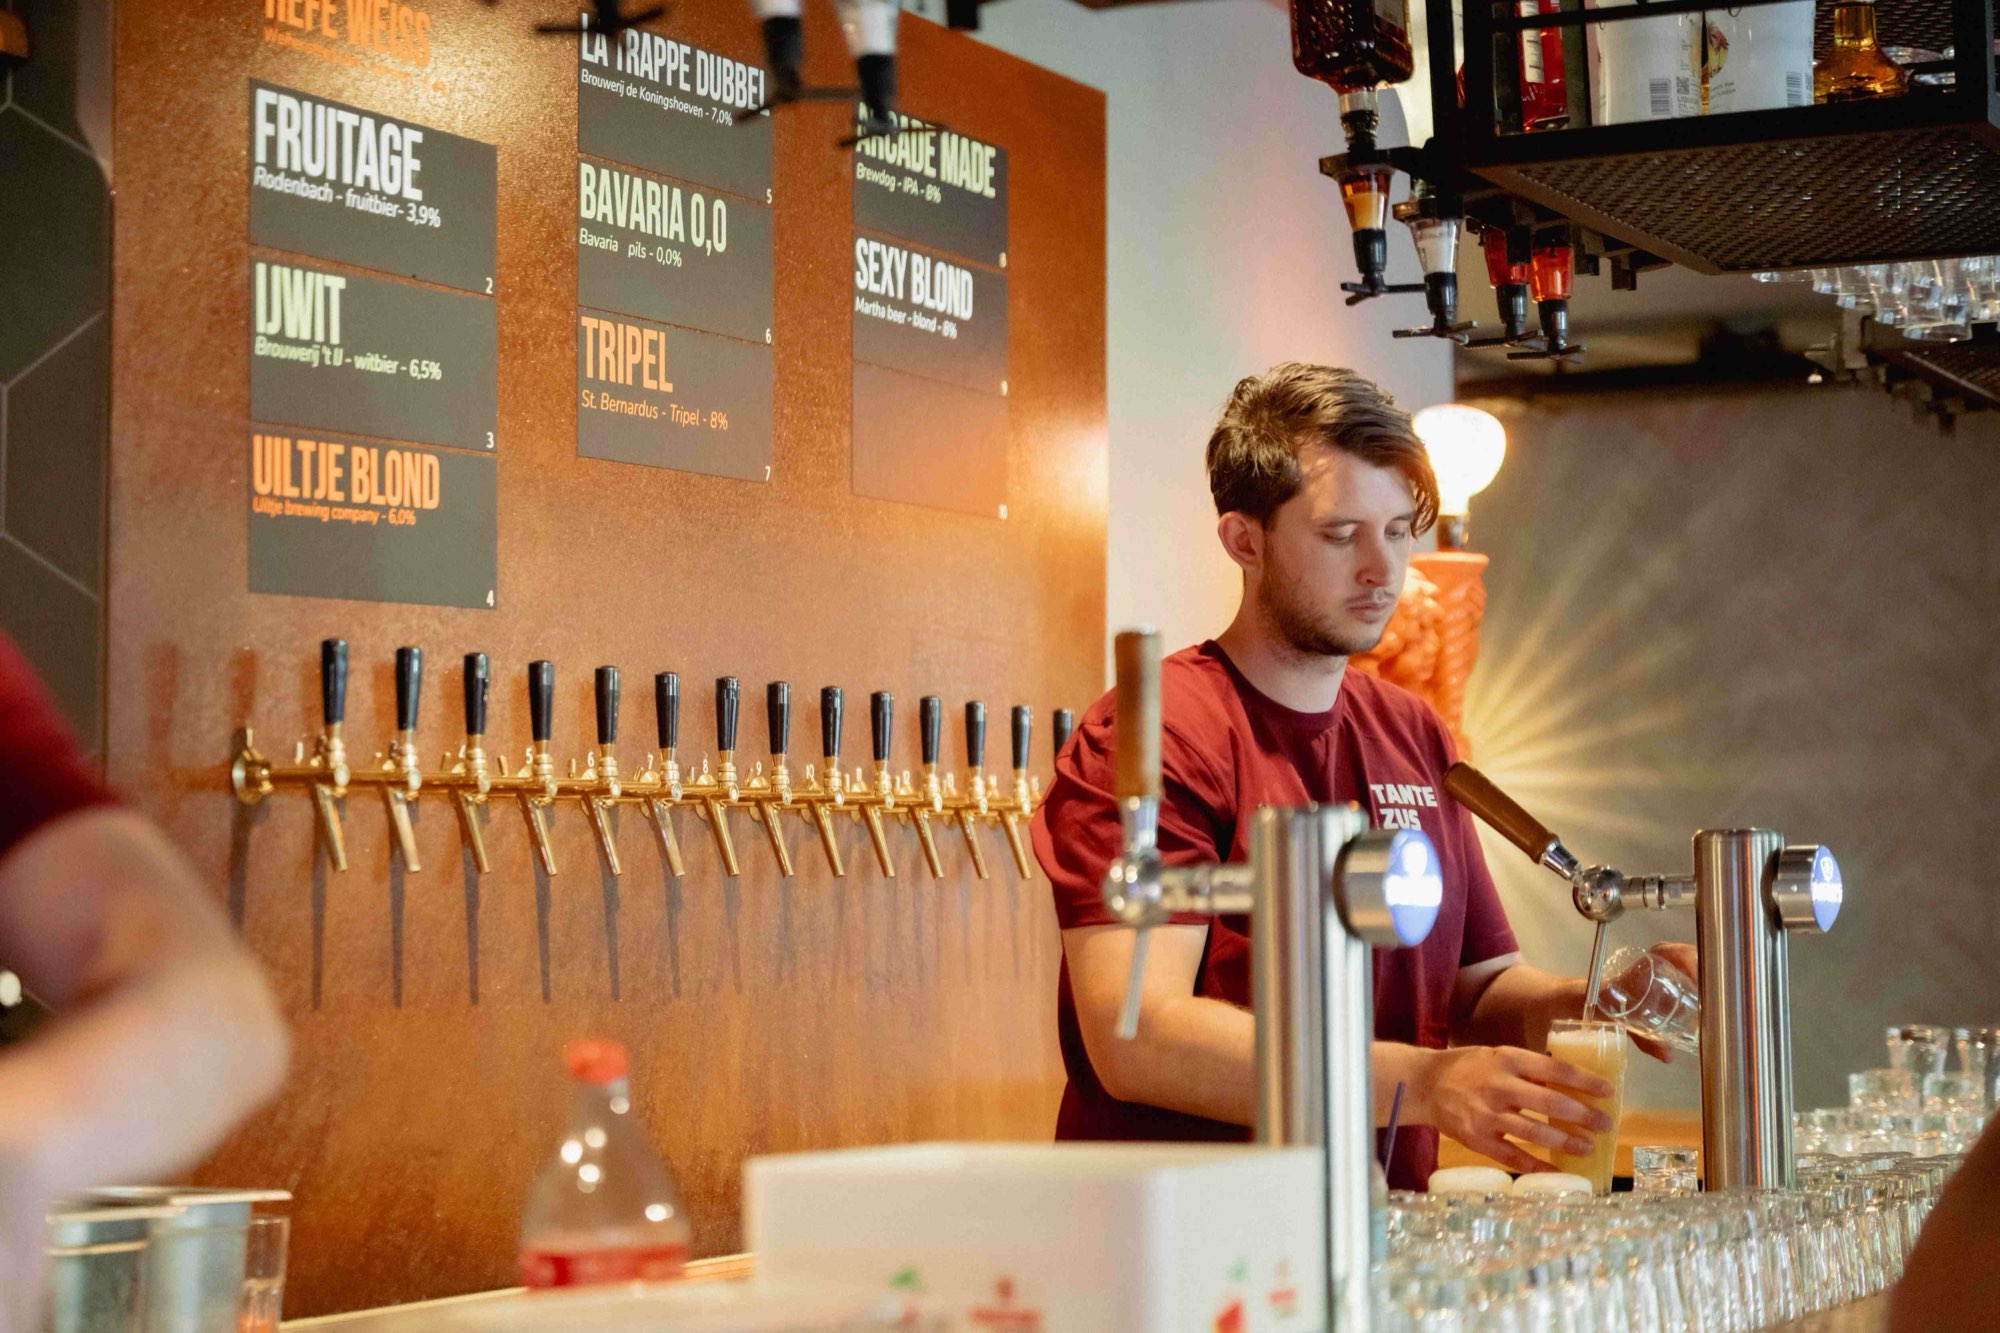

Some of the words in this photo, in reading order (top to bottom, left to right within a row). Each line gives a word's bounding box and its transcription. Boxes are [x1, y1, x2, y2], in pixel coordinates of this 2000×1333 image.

[347, 0, 431, 69] WEISS
[581, 13, 608, 67] LA
[696, 49, 770, 117] DUBBEL
[581, 68, 625, 97] Brouwerij
[626, 83, 638, 98] de
[639, 86, 703, 118] Koningshoeven
[711, 107, 732, 126] 7,0%
[255, 88, 423, 201] FRUITAGE
[940, 131, 996, 199] MADE
[254, 165, 333, 203] Rodenbach
[406, 202, 441, 228] 3,9%
[766, 188, 772, 204] 5
[856, 162, 896, 192] Brewdog
[903, 176, 918, 197] IPA
[925, 183, 941, 204] 8%
[580, 162, 685, 243] BAVARIA
[690, 193, 727, 256] 0,0
[579, 227, 619, 252] Bavaria
[628, 241, 647, 259] pils
[656, 246, 682, 267] 0,0%
[485, 277, 494, 294] 2
[855, 237, 908, 300] SEXY
[911, 253, 973, 321] BLOND
[765, 328, 771, 344] 6
[855, 296, 886, 319] Martha
[887, 304, 906, 325] beer
[912, 310, 937, 333] blond
[942, 319, 957, 340] 8%
[255, 336, 320, 368] Brouwerij
[354, 352, 399, 374] witbier
[409, 359, 442, 380] 6,5%
[581, 316, 673, 393] TRIPEL
[581, 389, 597, 409] St.
[600, 392, 658, 420] Bernardus
[670, 404, 699, 428] Tripel
[710, 411, 728, 431] 8%
[486, 432, 494, 448] 3
[253, 434, 345, 502] UILTJE
[351, 446, 440, 510] BLOND
[765, 466, 771, 481] 7
[284, 498, 331, 522] brewing
[331, 507, 380, 525] company
[388, 508, 416, 526] 6,0%
[486, 590, 494, 607] 4
[1370, 783, 1438, 807] TANTE
[1379, 808, 1422, 831] ZUS
